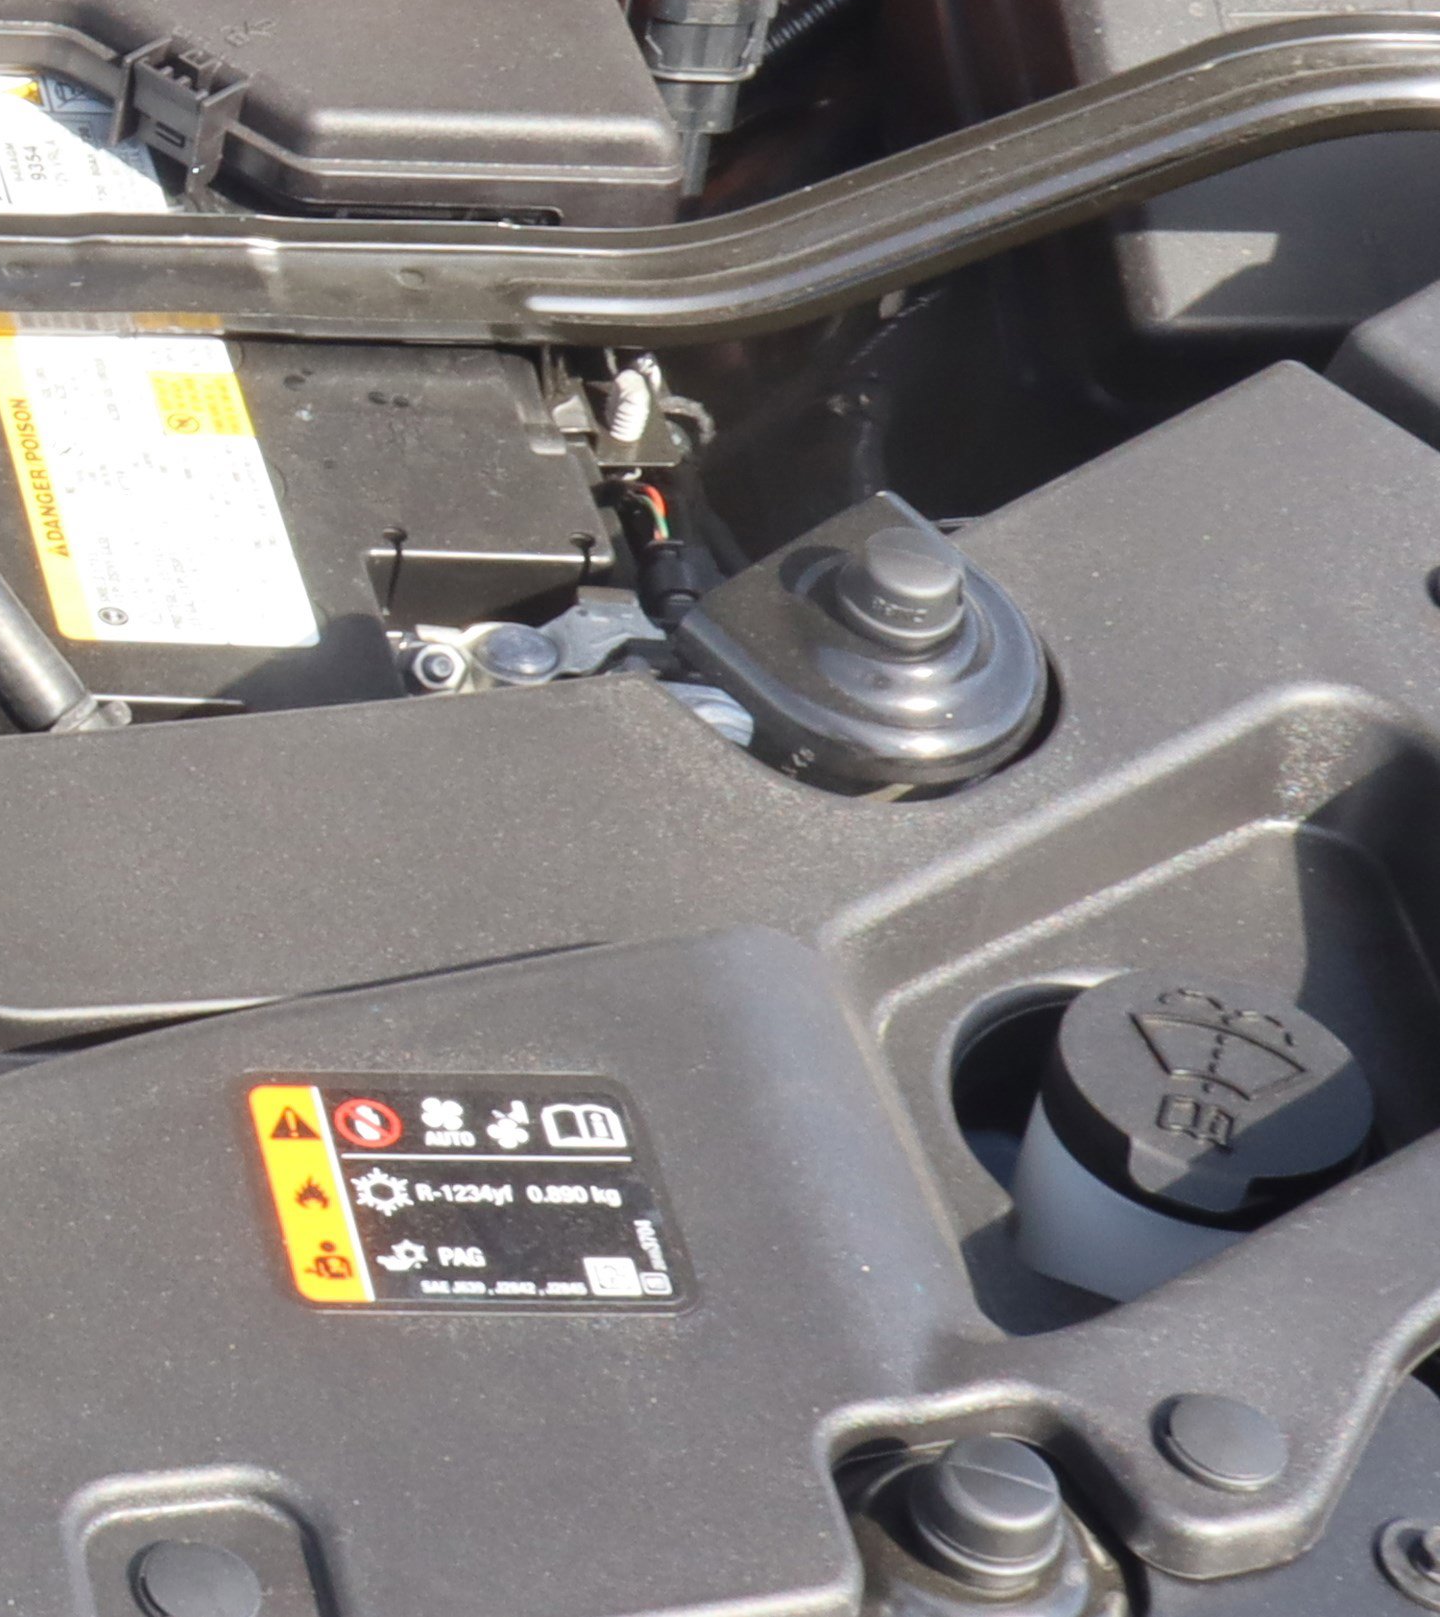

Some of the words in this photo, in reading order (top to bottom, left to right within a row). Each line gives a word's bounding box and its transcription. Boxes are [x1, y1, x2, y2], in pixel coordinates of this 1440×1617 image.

[23, 145, 47, 181] 9354
[9, 398, 43, 463] POISON
[30, 469, 66, 541] DANGER
[425, 1130, 477, 1147] AUTO
[415, 1184, 513, 1207] R-1234yf
[526, 1185, 589, 1204] 0.890
[591, 1186, 622, 1207] kg
[437, 1246, 487, 1268] PAG
